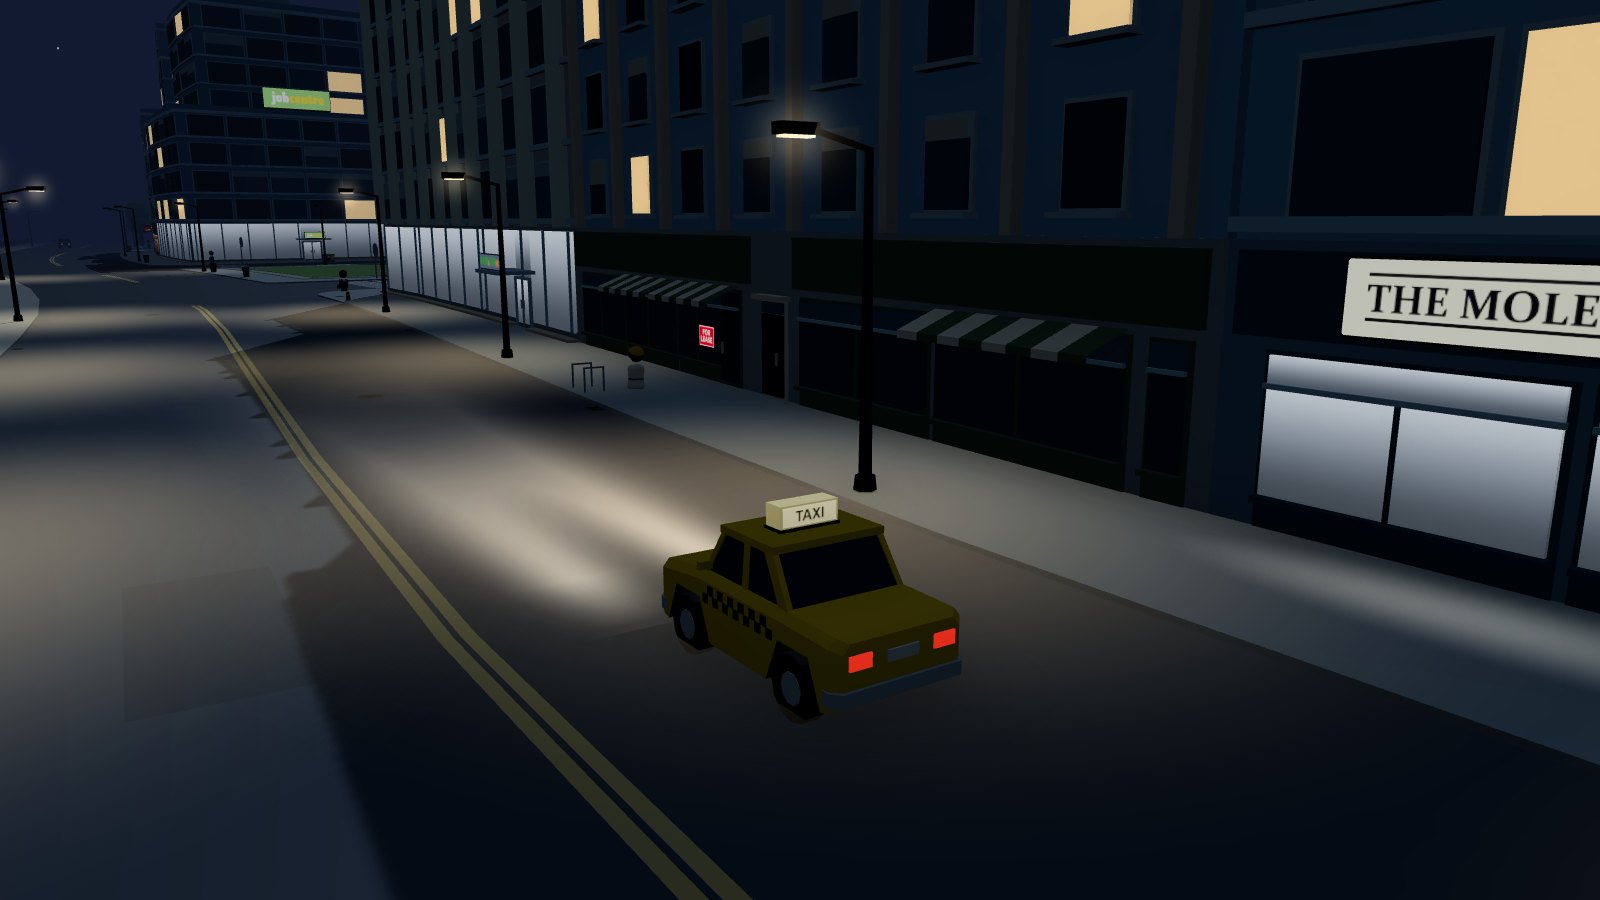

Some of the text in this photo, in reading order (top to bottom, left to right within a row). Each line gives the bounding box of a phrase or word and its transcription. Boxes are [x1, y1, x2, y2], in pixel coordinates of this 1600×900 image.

[1367, 284, 1600, 328] THE MOLE
[702, 328, 711, 336] FOR
[700, 335, 713, 344] LEASE
[796, 506, 825, 522] TAXI
